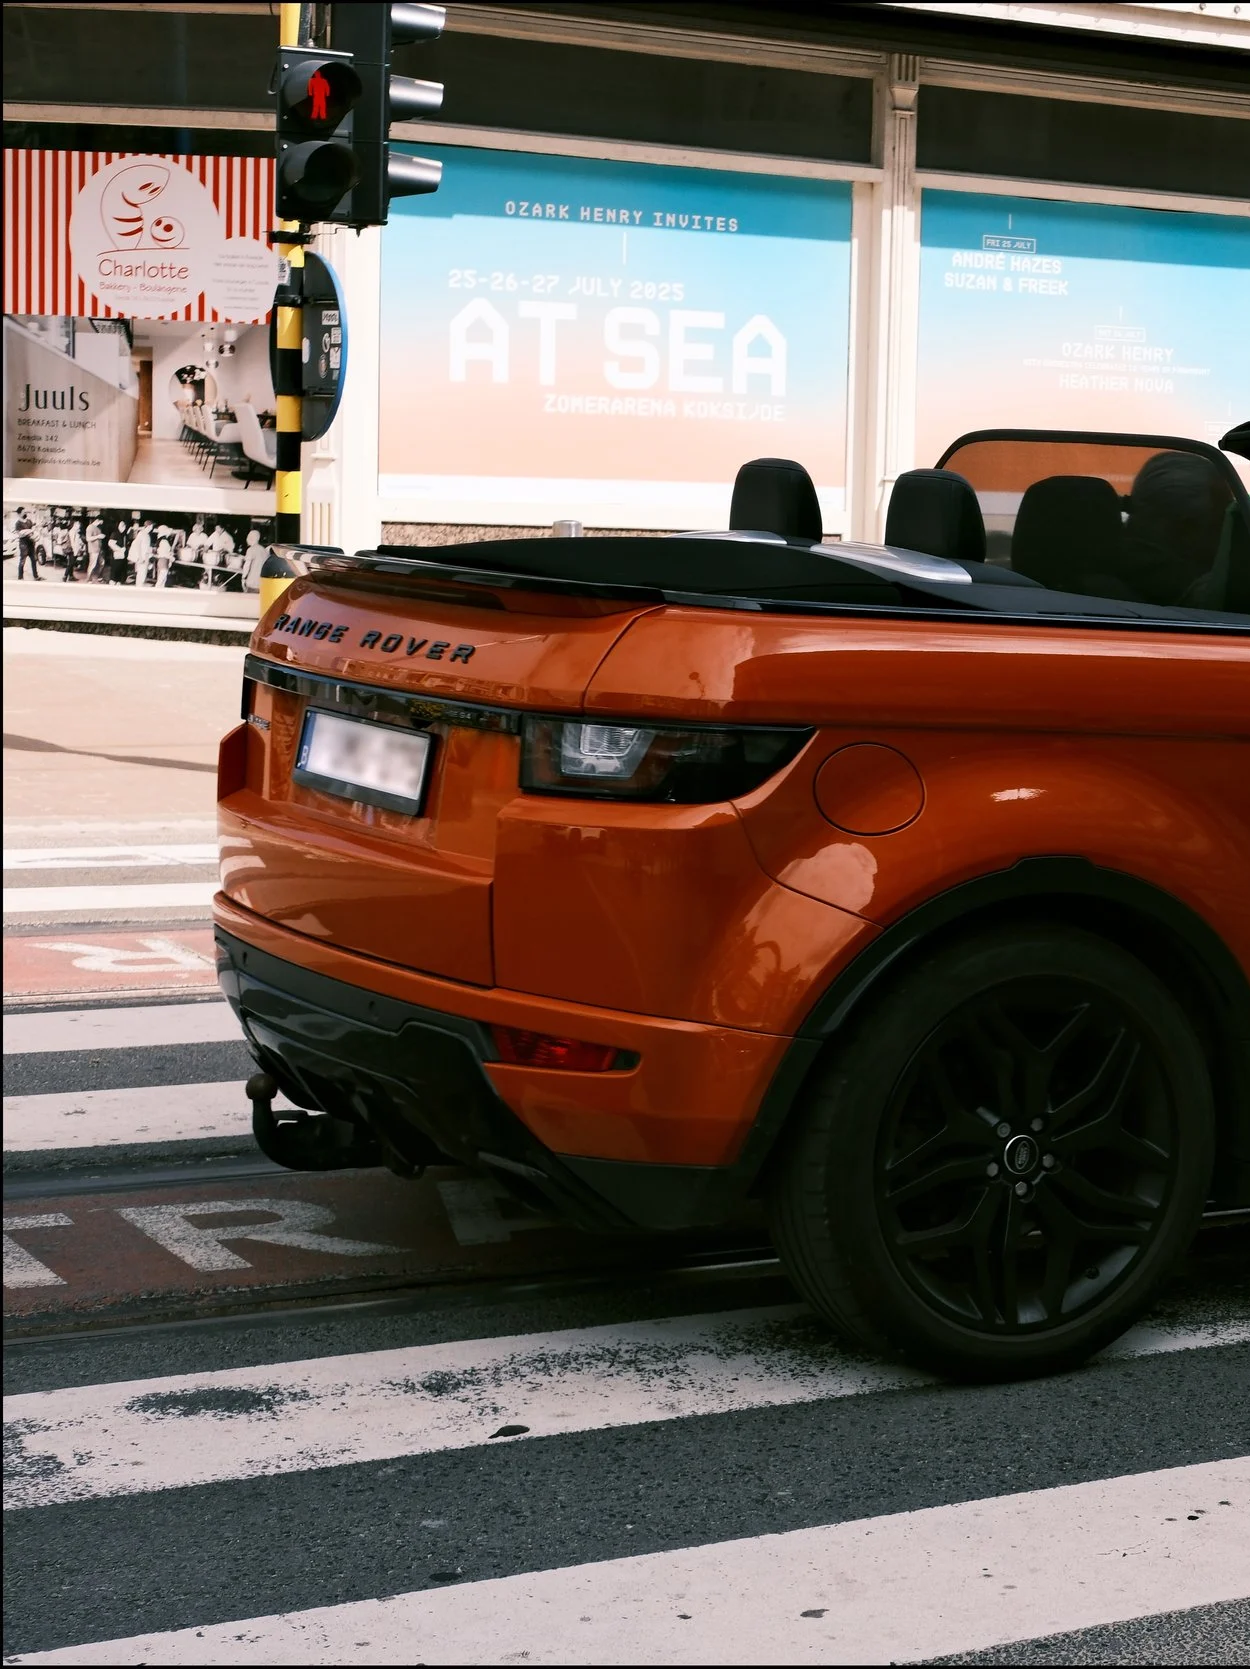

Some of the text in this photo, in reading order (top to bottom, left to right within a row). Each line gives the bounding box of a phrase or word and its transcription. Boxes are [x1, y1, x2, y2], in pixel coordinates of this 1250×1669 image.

[505, 200, 739, 232] OZARK HENRY INVITES
[986, 238, 1000, 248] FRI
[1013, 241, 1032, 250] JULY
[98, 258, 189, 280] Charlotte
[952, 251, 1062, 274] ANDRÉ HAZES
[448, 269, 684, 301] 25-26-27 JULY 2025
[944, 272, 997, 291] SUZAN
[1018, 278, 1069, 296] FREEK
[449, 297, 787, 397] AT SEA
[1062, 342, 1174, 363] OZARK HENRY
[1059, 374, 1174, 394] HEATHER NOVA
[18, 383, 90, 412] Juuls
[544, 394, 787, 422] ZOMERARENA KOKSIJDE
[17, 418, 59, 428] BREAKFAST
[69, 420, 97, 429] LUNCH
[273, 613, 476, 664] RANGE ROVER
